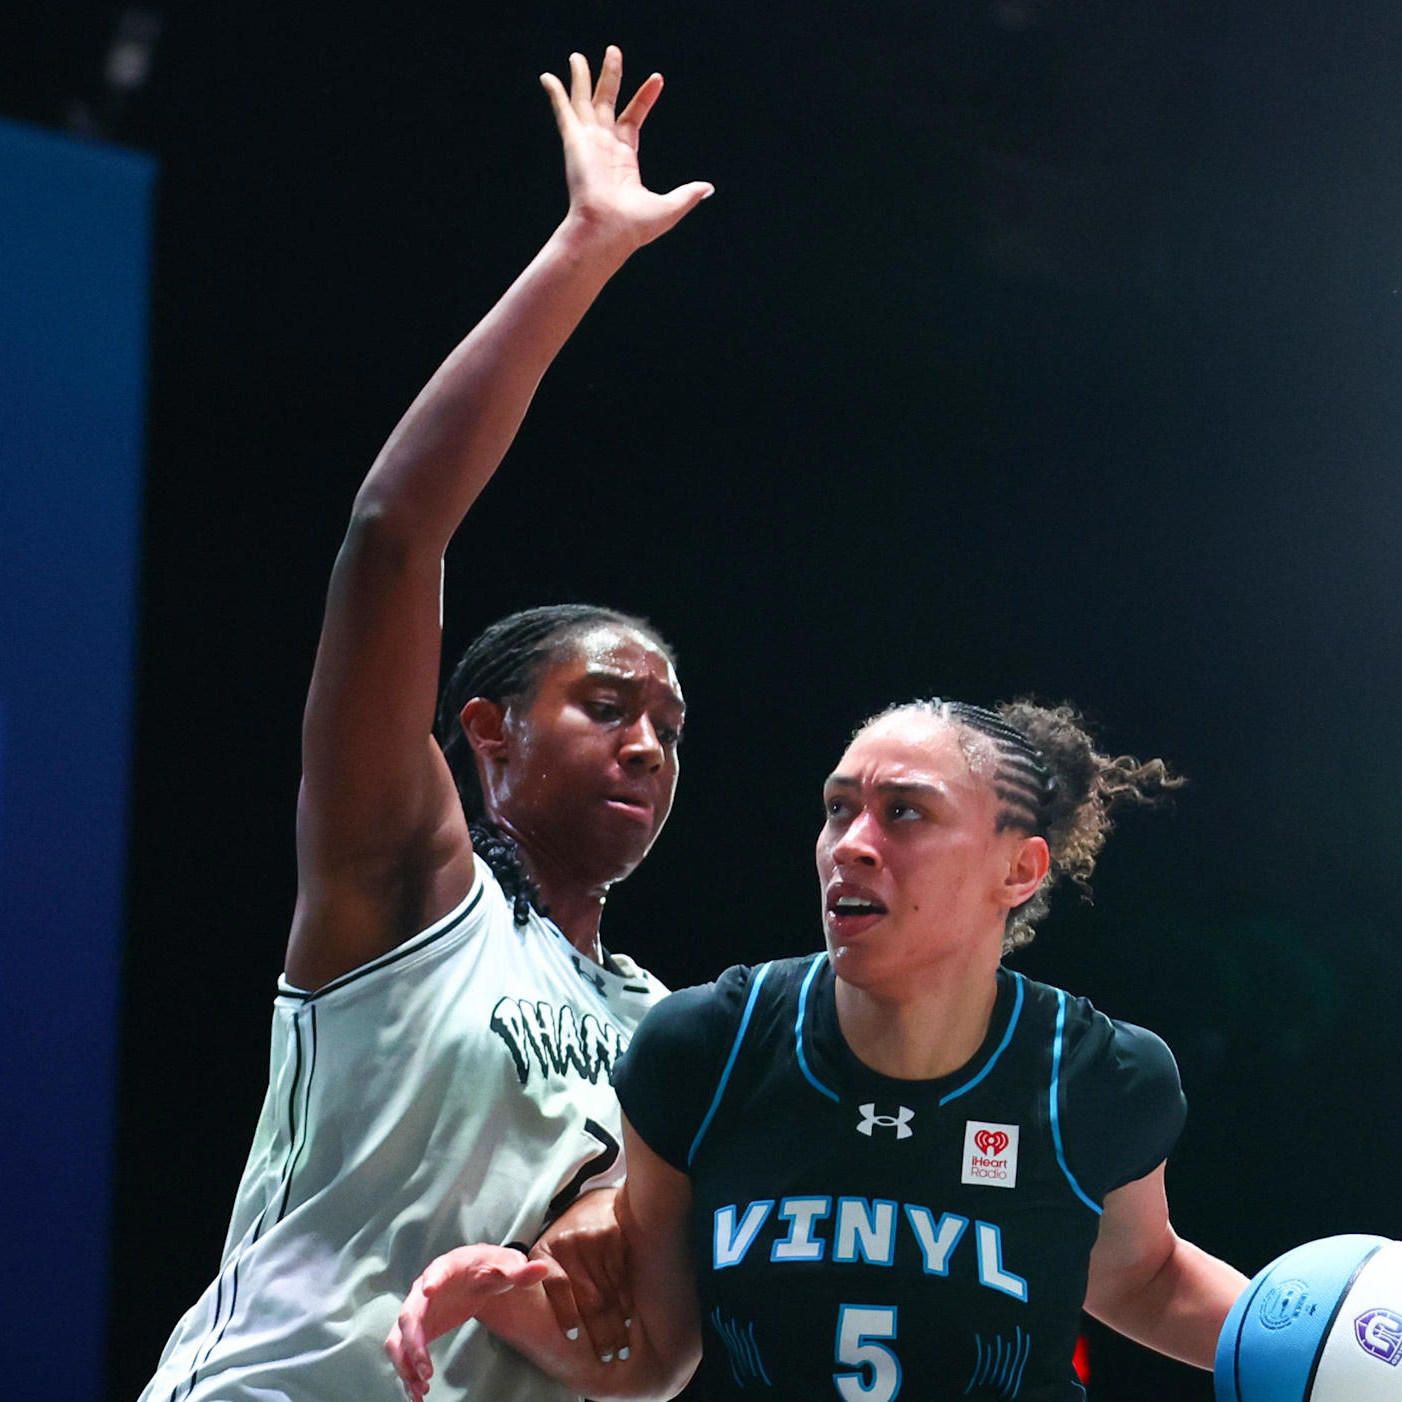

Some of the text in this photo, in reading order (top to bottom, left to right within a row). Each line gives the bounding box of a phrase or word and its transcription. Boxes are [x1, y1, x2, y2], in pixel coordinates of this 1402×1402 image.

[490, 996, 630, 1087] PHAN
[971, 1166, 1008, 1181] Radio
[972, 1155, 1008, 1169] iHeart
[713, 1195, 1028, 1303] VINYL
